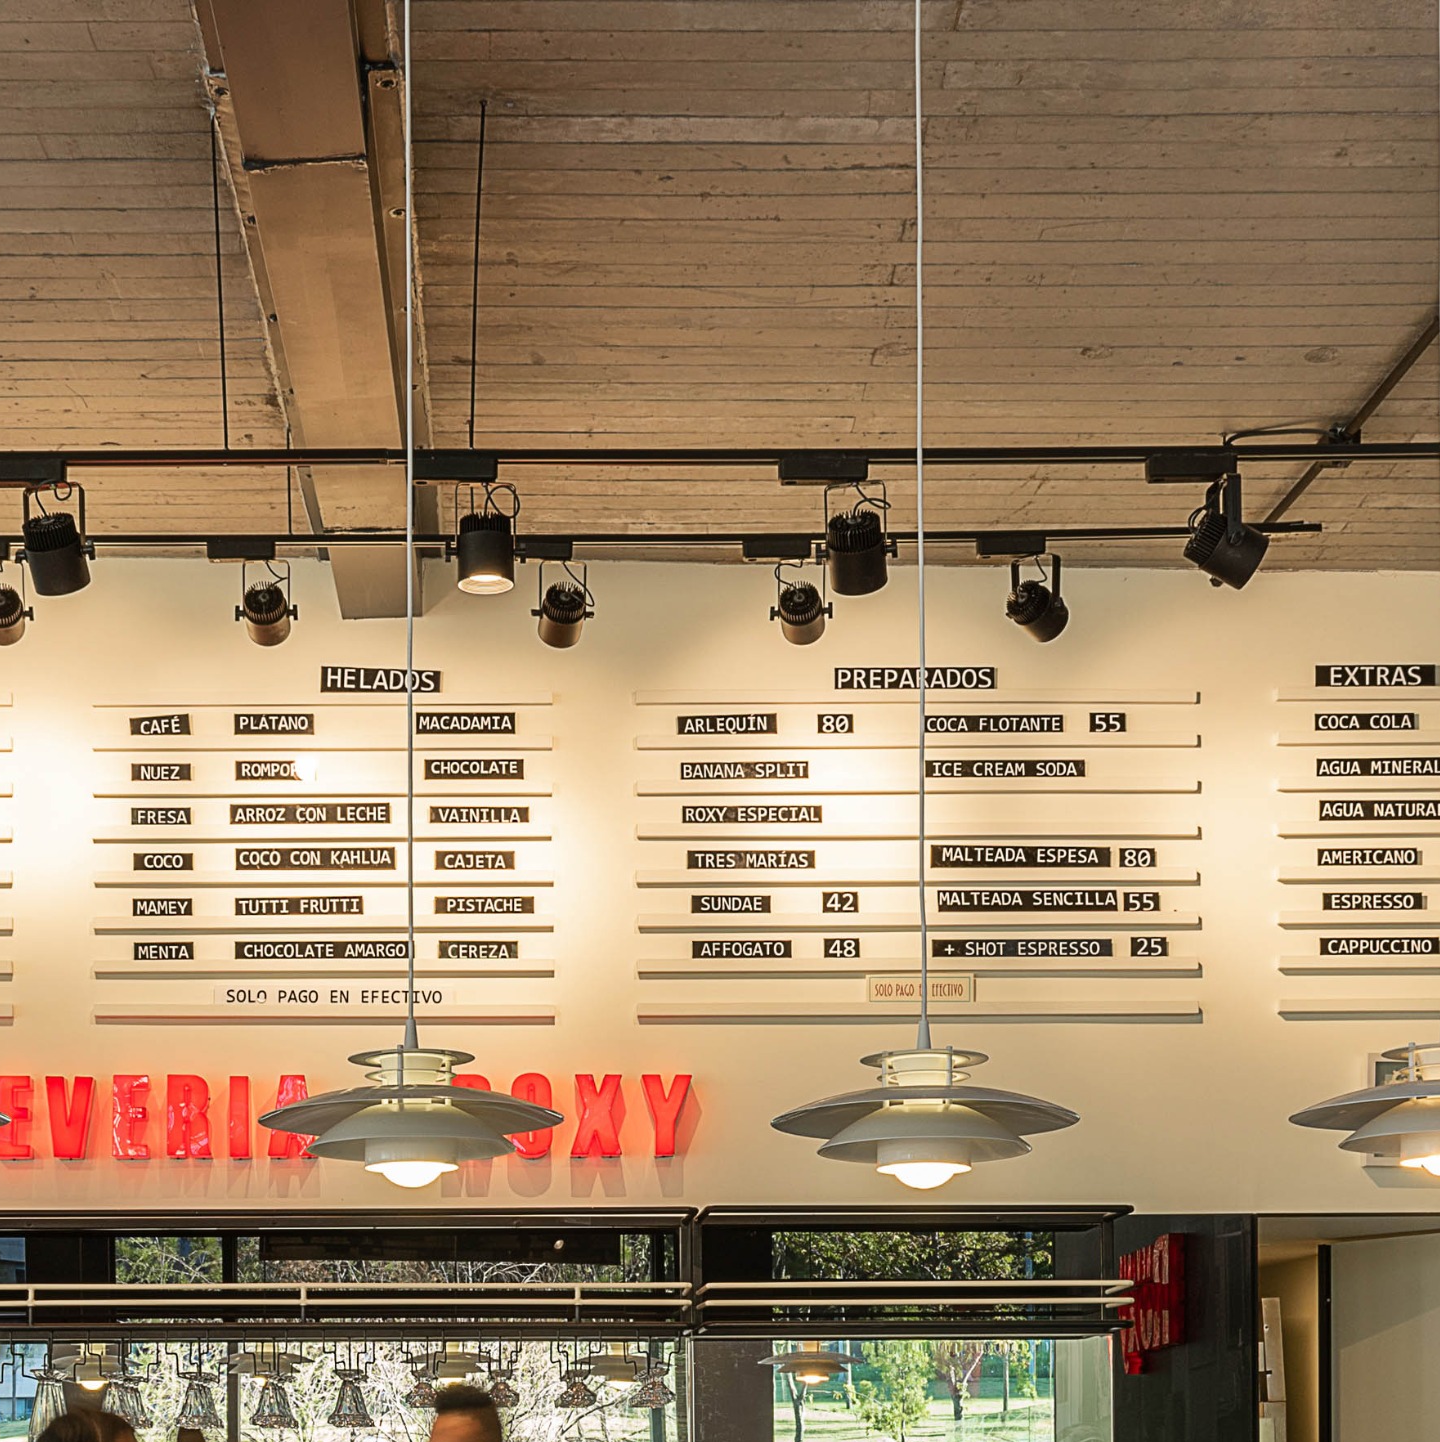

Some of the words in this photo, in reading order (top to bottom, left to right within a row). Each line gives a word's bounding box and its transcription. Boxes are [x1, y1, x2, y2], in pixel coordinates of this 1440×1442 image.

[326, 668, 435, 691] HELADOS
[837, 669, 992, 689] PREPARADOS
[1330, 666, 1421, 686] EXTRAS
[140, 716, 180, 734] CAFÉ
[240, 714, 308, 731] PLÁTANO
[419, 715, 512, 731] MACADAMIA
[683, 715, 768, 734] ARLEQUÍN
[821, 716, 849, 733] 80
[926, 716, 970, 732] COCA
[978, 716, 1061, 732] FLOTANTE
[1094, 714, 1121, 732] 55
[1318, 715, 1360, 729] COCA
[1370, 714, 1412, 729] COLA
[140, 765, 180, 780] NUEZ
[241, 763, 298, 777] ROMPO
[431, 760, 518, 776] CHOCOLATE
[682, 763, 744, 779] BANANA
[754, 762, 806, 778] SPLIT
[932, 761, 962, 777] ICE
[974, 761, 1026, 777] CREAM
[1036, 761, 1078, 777] SODA
[1319, 760, 1360, 775] AGUA
[137, 809, 187, 824] FRESA
[235, 807, 286, 822] ARROZ
[296, 807, 327, 822] CON
[337, 806, 387, 821] LECHE
[439, 808, 520, 823] VAINILLA
[685, 807, 726, 822] ROXY
[737, 807, 820, 822] ESPECIAL
[1322, 803, 1364, 818] AGUA
[144, 855, 183, 870] COCO
[239, 851, 281, 866] COCO
[290, 850, 321, 866] CON
[330, 849, 391, 865] KAHLUA
[444, 854, 505, 869] CAJETA
[694, 852, 736, 868] TRES
[746, 850, 808, 868] MARÍAS
[941, 847, 1022, 864] MALTEADA
[1037, 848, 1099, 864] ESPESA
[1123, 849, 1152, 867] 80
[1321, 849, 1415, 864] AMERICANO
[137, 900, 188, 915] MAMEY
[239, 899, 289, 914] TUTTI
[300, 897, 360, 913] FRUTTI
[447, 898, 522, 912] PISTACHE
[700, 896, 762, 912] SUNDAE
[826, 893, 855, 911] 42
[938, 891, 1023, 907] MALTEADA
[1032, 891, 1116, 907] SENCILLA
[1127, 893, 1155, 911] 55
[1331, 894, 1414, 909] ESPRESSO
[138, 945, 189, 960] MENTA
[244, 943, 334, 958] CHOCOLATE
[344, 943, 406, 958] AMARGO
[447, 943, 509, 959] CEREZA
[701, 941, 784, 957] AFFOGATO
[828, 939, 856, 958] 48
[965, 940, 1007, 956] SHOT
[1017, 940, 1100, 956] ESPRESSO
[1135, 938, 1163, 956] 25
[1327, 939, 1432, 954] CAPPUCCINO
[226, 989, 267, 1004] SOLO
[278, 989, 318, 1004] PAGO
[330, 989, 349, 1004] EN
[360, 989, 442, 1004] EFECTIVO
[875, 984, 893, 997] SOLO
[896, 984, 915, 997] PAGO
[932, 984, 963, 997] EFECTIVO
[453, 1073, 693, 1158] OXY
